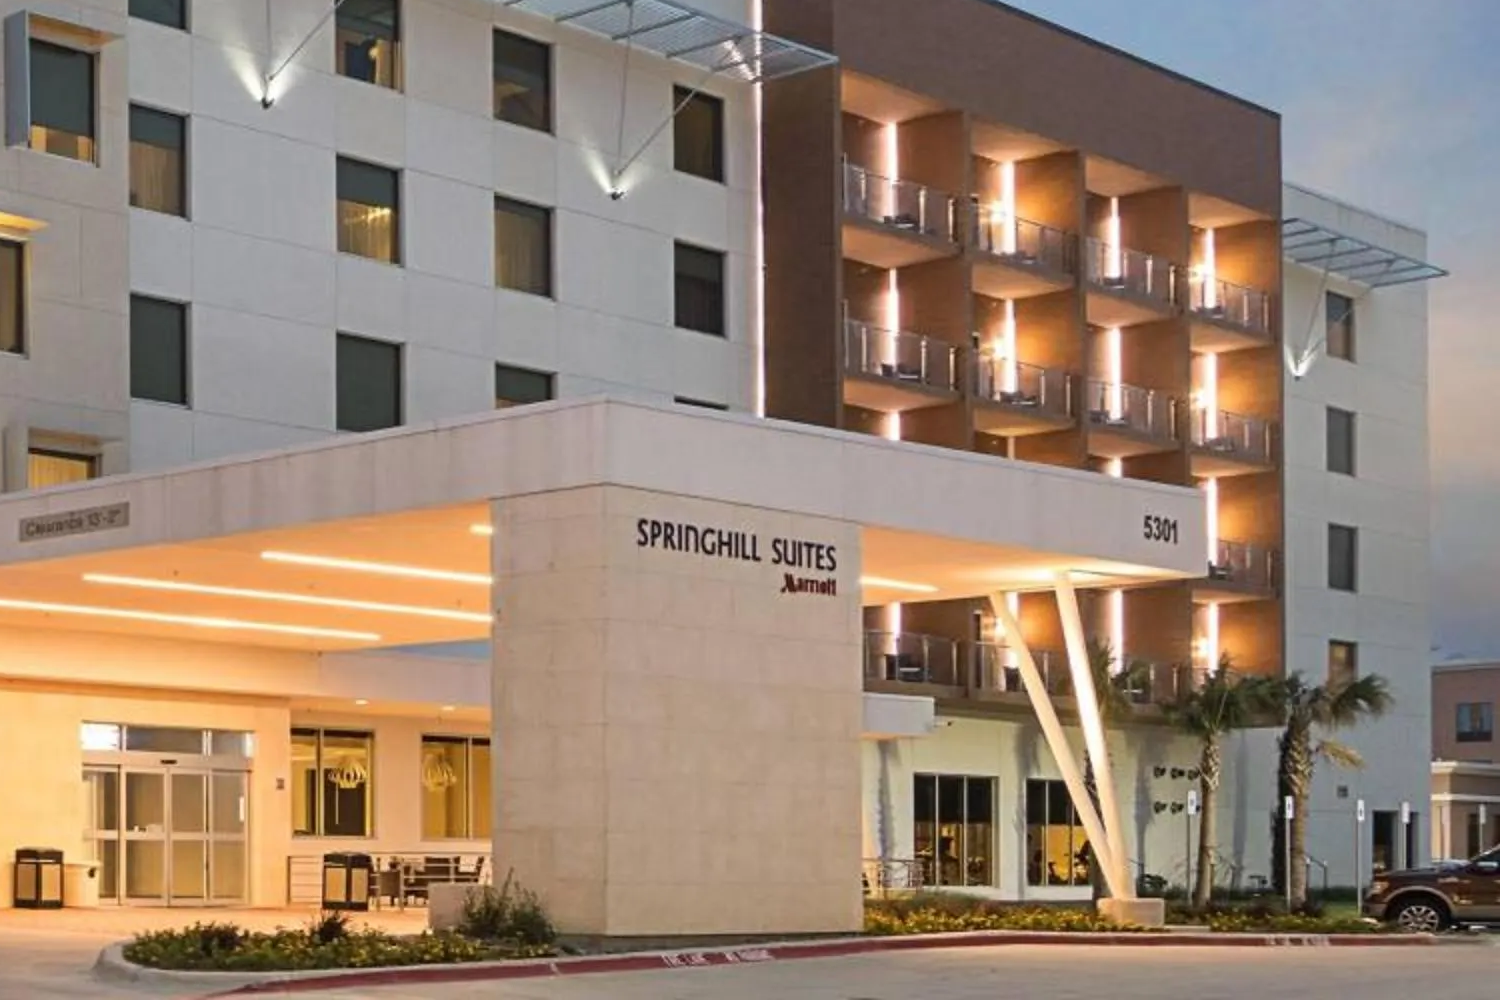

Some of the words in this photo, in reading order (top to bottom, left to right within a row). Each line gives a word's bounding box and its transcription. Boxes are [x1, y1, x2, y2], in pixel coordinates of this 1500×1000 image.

[637, 518, 761, 562] SPRINGHILL
[771, 538, 837, 571] SUITES
[1143, 514, 1178, 545] 5301
